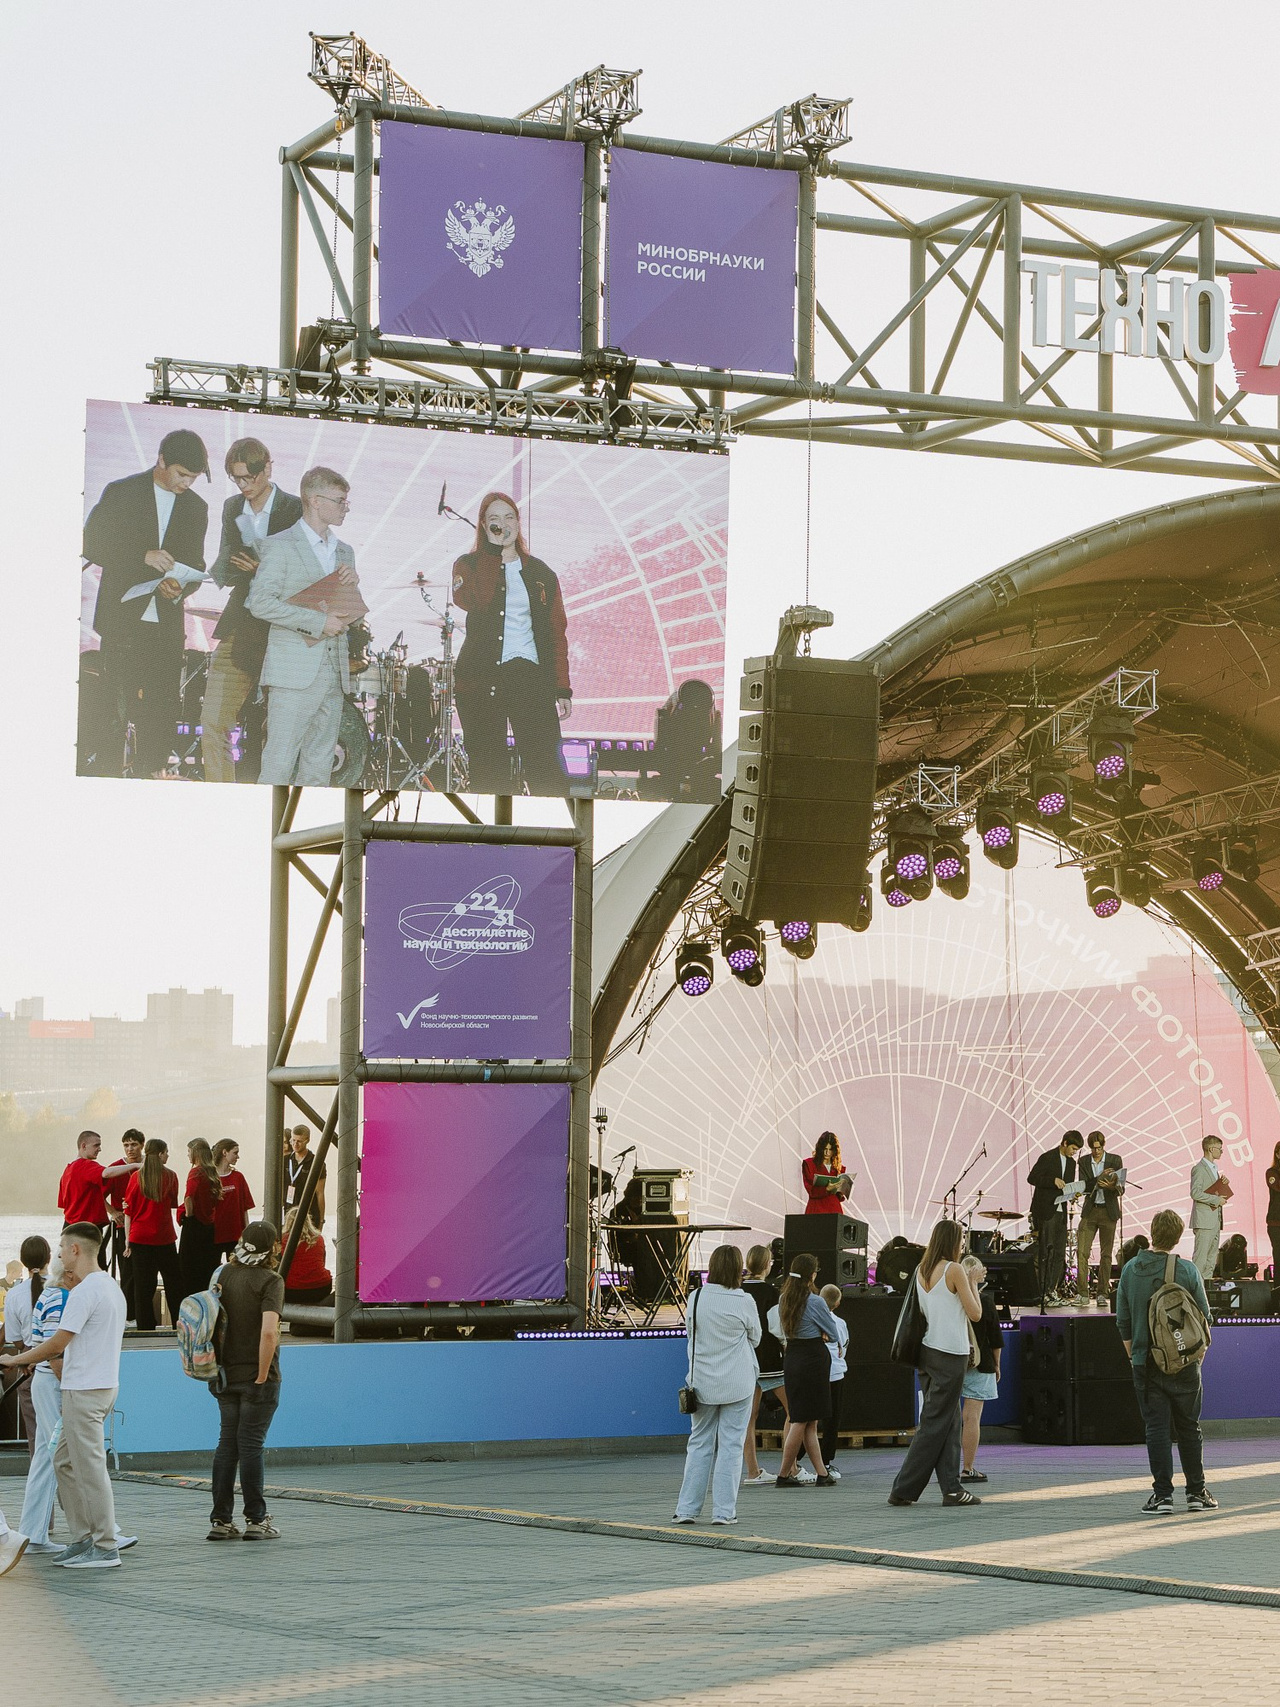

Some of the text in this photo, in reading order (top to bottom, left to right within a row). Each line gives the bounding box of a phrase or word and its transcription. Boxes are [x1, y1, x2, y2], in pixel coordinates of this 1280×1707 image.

[636, 241, 766, 272] МИНОБРНАУКИ
[636, 260, 707, 283] РОССИИ
[1020, 259, 1226, 366] ТЕХНО
[469, 892, 499, 911] 22
[494, 909, 515, 926] 31
[442, 926, 529, 939] десятилетие
[403, 938, 528, 952] науки и технологий
[420, 1012, 438, 1022] Фонд
[420, 1021, 490, 1030] Новосибирской области
[964, 882, 1254, 1168] СТОЧНИК ФОТОНОВ
